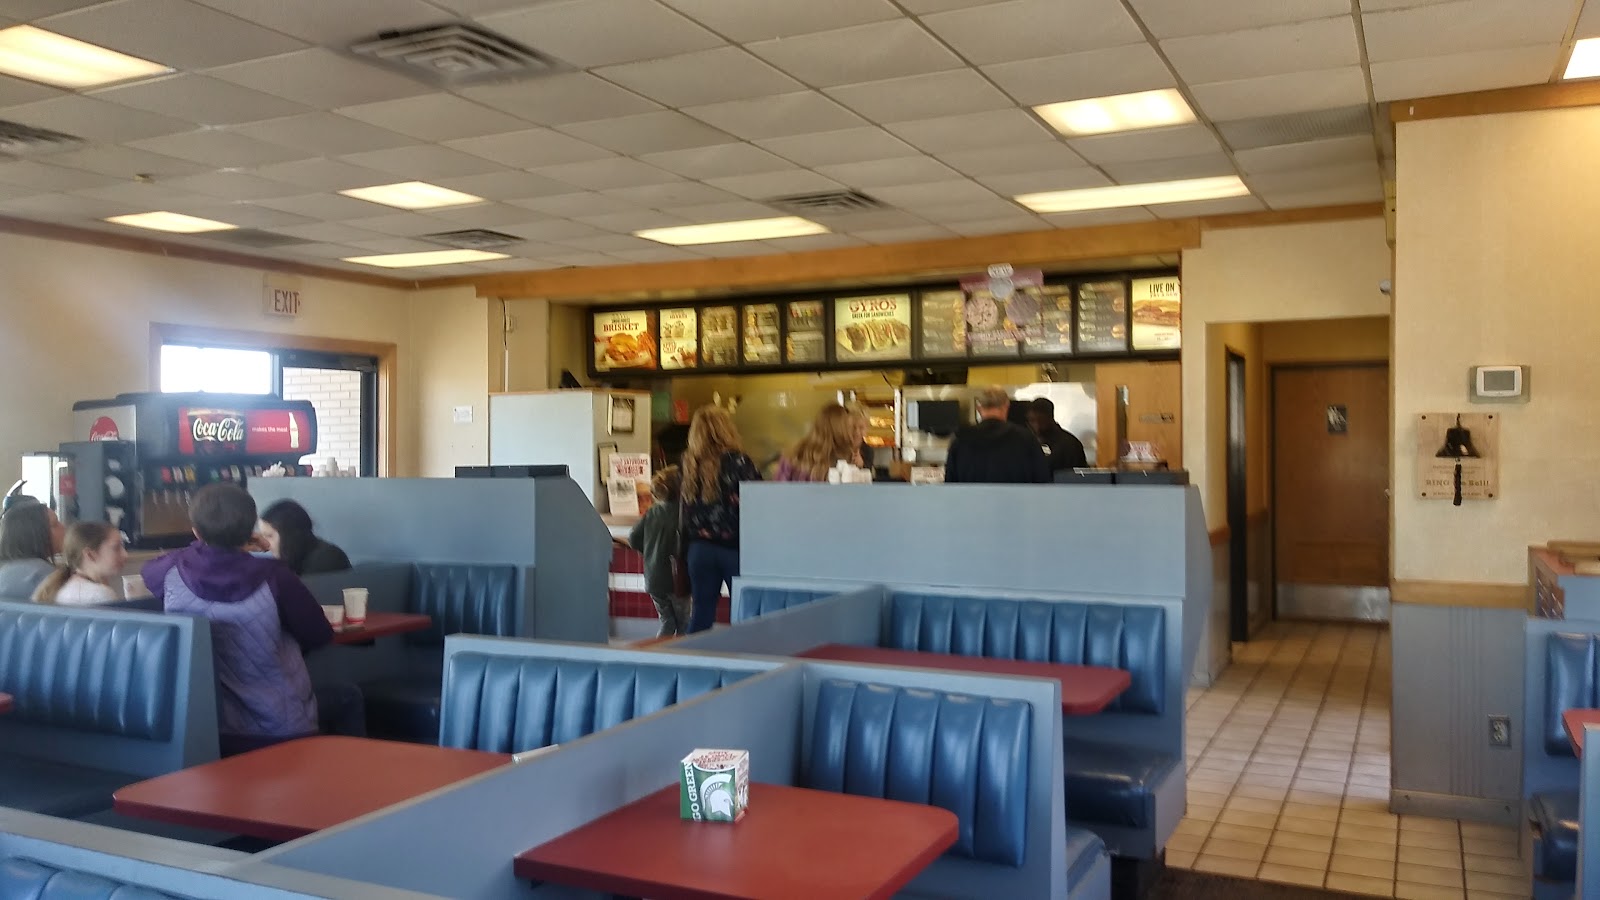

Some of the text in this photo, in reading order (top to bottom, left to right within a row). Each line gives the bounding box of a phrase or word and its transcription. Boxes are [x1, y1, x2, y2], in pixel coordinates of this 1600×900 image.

[1149, 282, 1175, 293] LIVE ON
[274, 289, 299, 314] EXIT
[849, 297, 897, 313] GYROS
[603, 323, 639, 332] BRISKET
[193, 417, 244, 442] Coca-Cola
[1426, 479, 1450, 487] RING
[691, 803, 702, 822] GO
